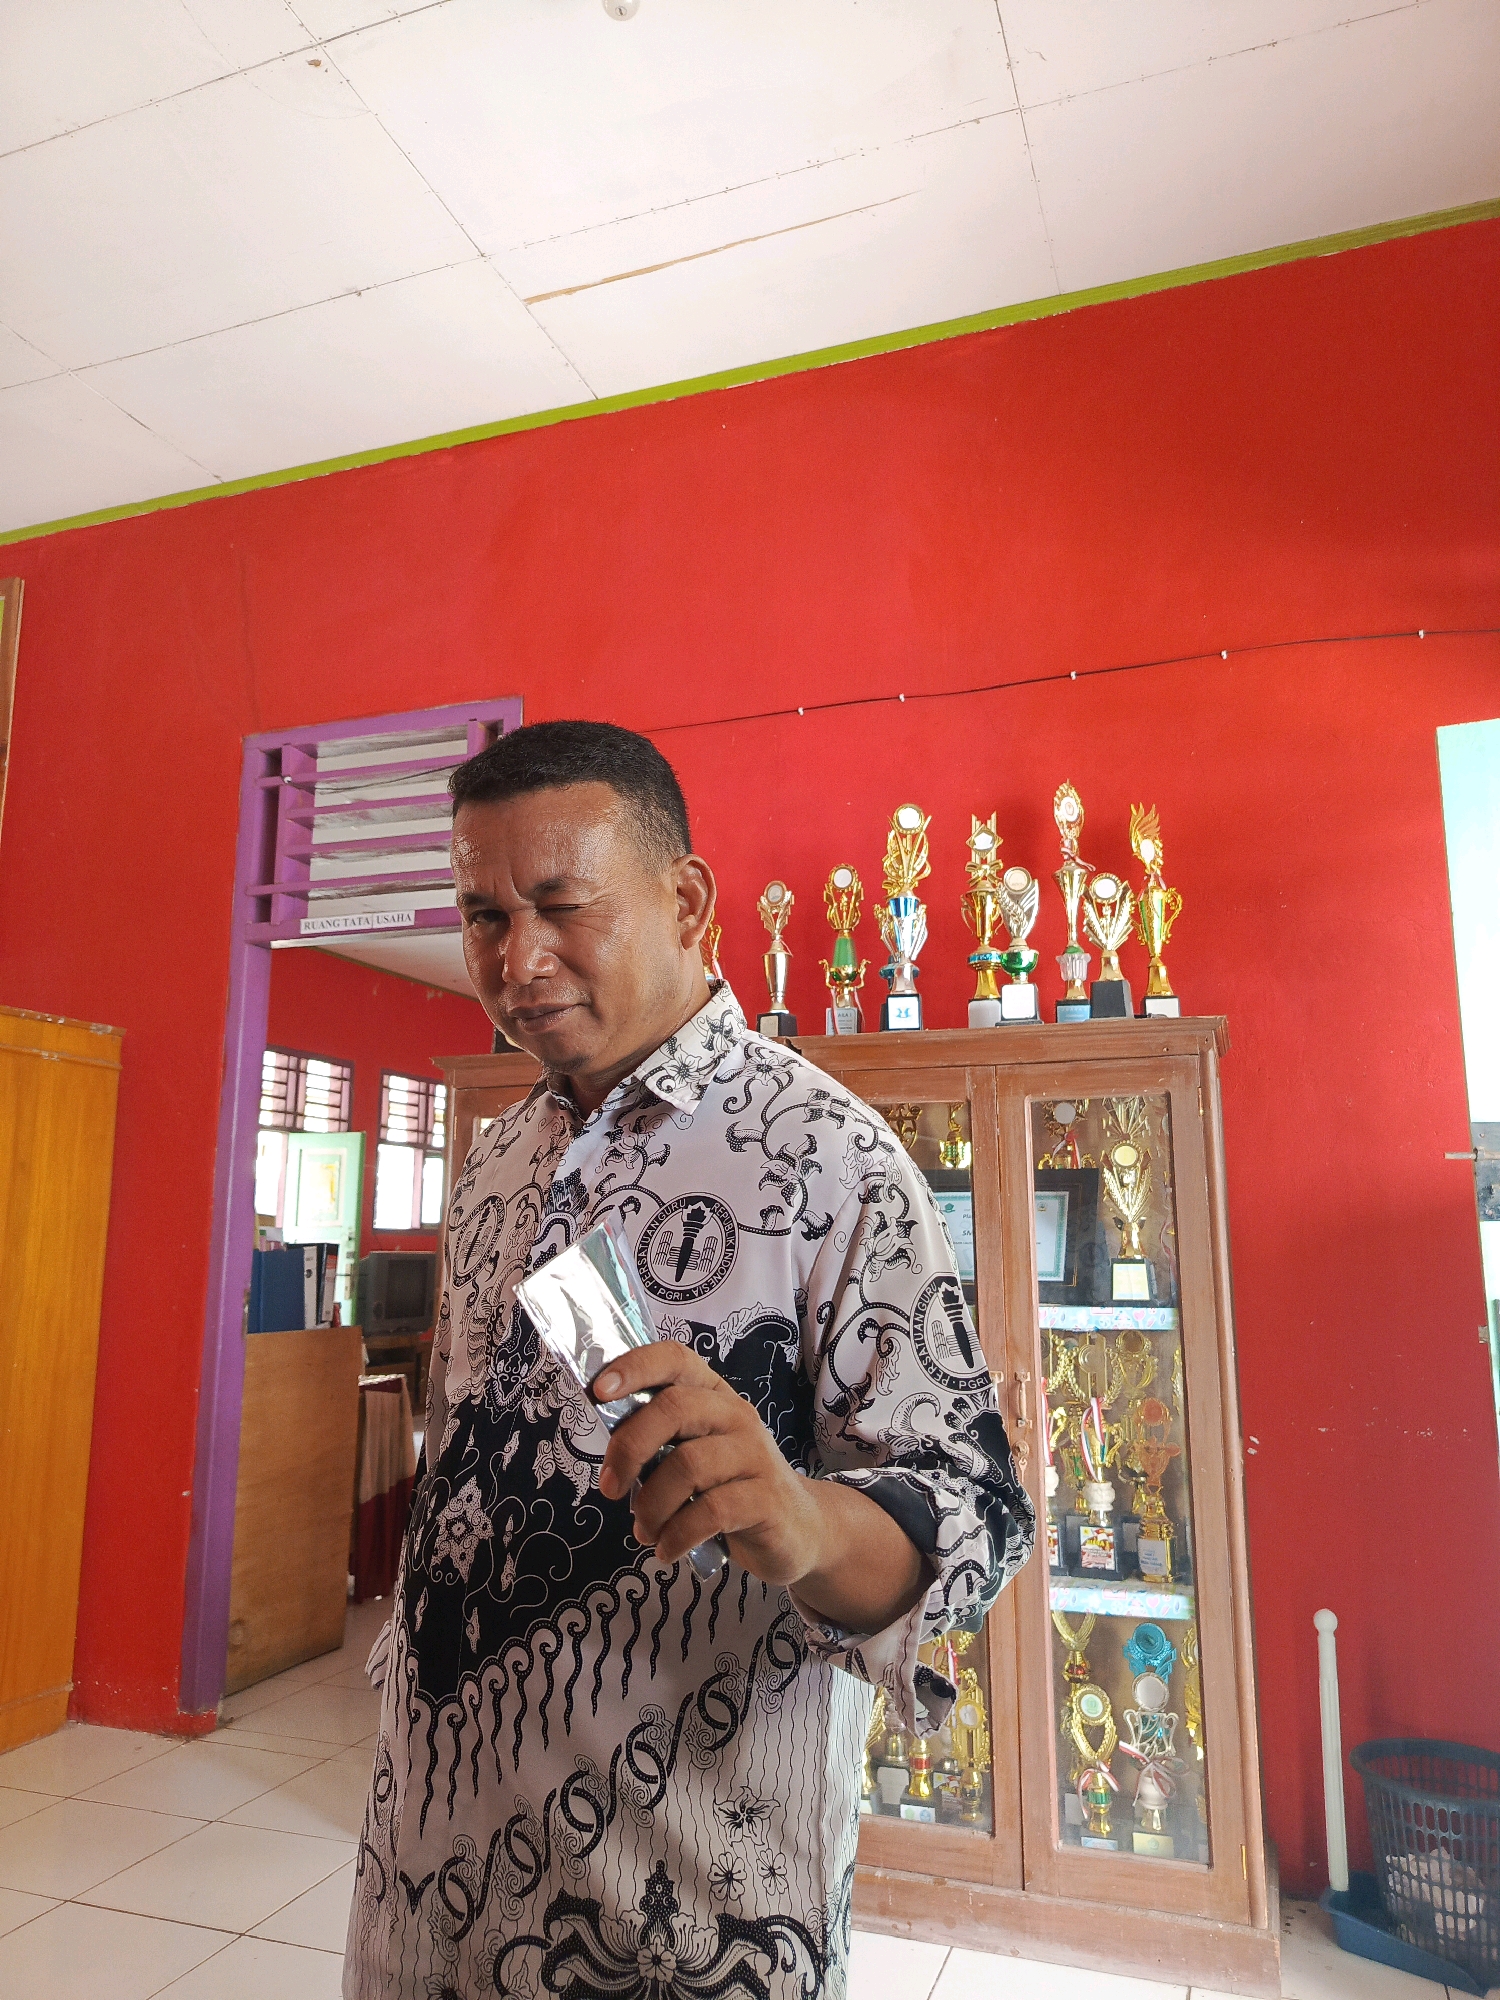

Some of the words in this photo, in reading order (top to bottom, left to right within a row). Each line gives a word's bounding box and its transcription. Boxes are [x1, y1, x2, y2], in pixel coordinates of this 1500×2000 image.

[304, 919, 340, 931] RUANG
[343, 917, 371, 927] TATA
[376, 913, 412, 925] USAHA
[658, 1198, 686, 1221] GURU
[711, 1202, 736, 1247] REPUBLIK
[637, 1221, 660, 1288] PERSATUAN
[691, 1248, 736, 1297] INDONESIA
[656, 1287, 683, 1301] PGRI
[917, 1280, 938, 1311] GURU
[913, 1313, 951, 1386] PERSATUAN
[958, 1376, 989, 1389] PGRI
